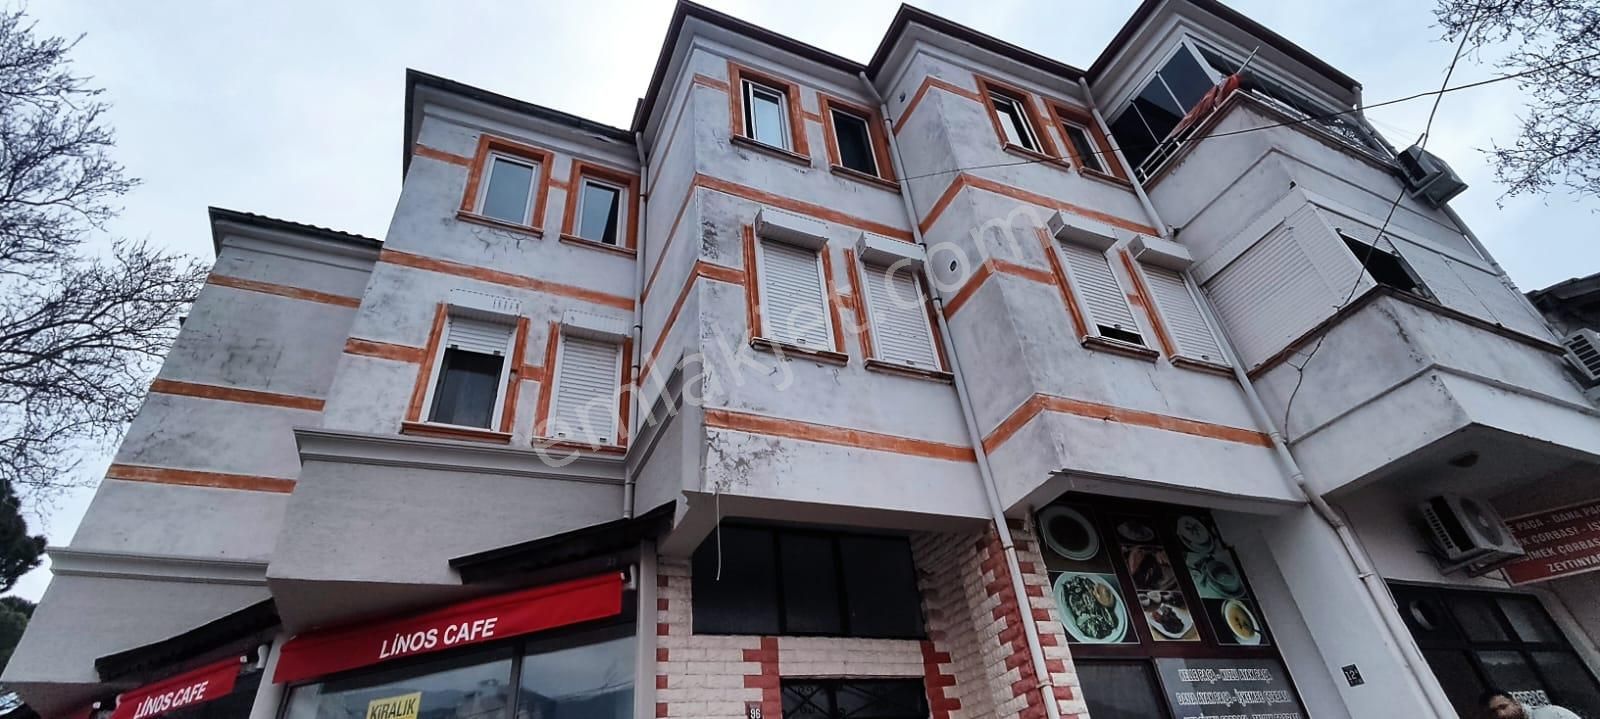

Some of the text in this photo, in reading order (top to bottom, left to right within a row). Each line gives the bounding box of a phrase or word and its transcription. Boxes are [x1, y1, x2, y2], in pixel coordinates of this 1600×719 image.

[379, 617, 498, 659] LİNOS CAFE
[172, 680, 209, 708] CAFE
